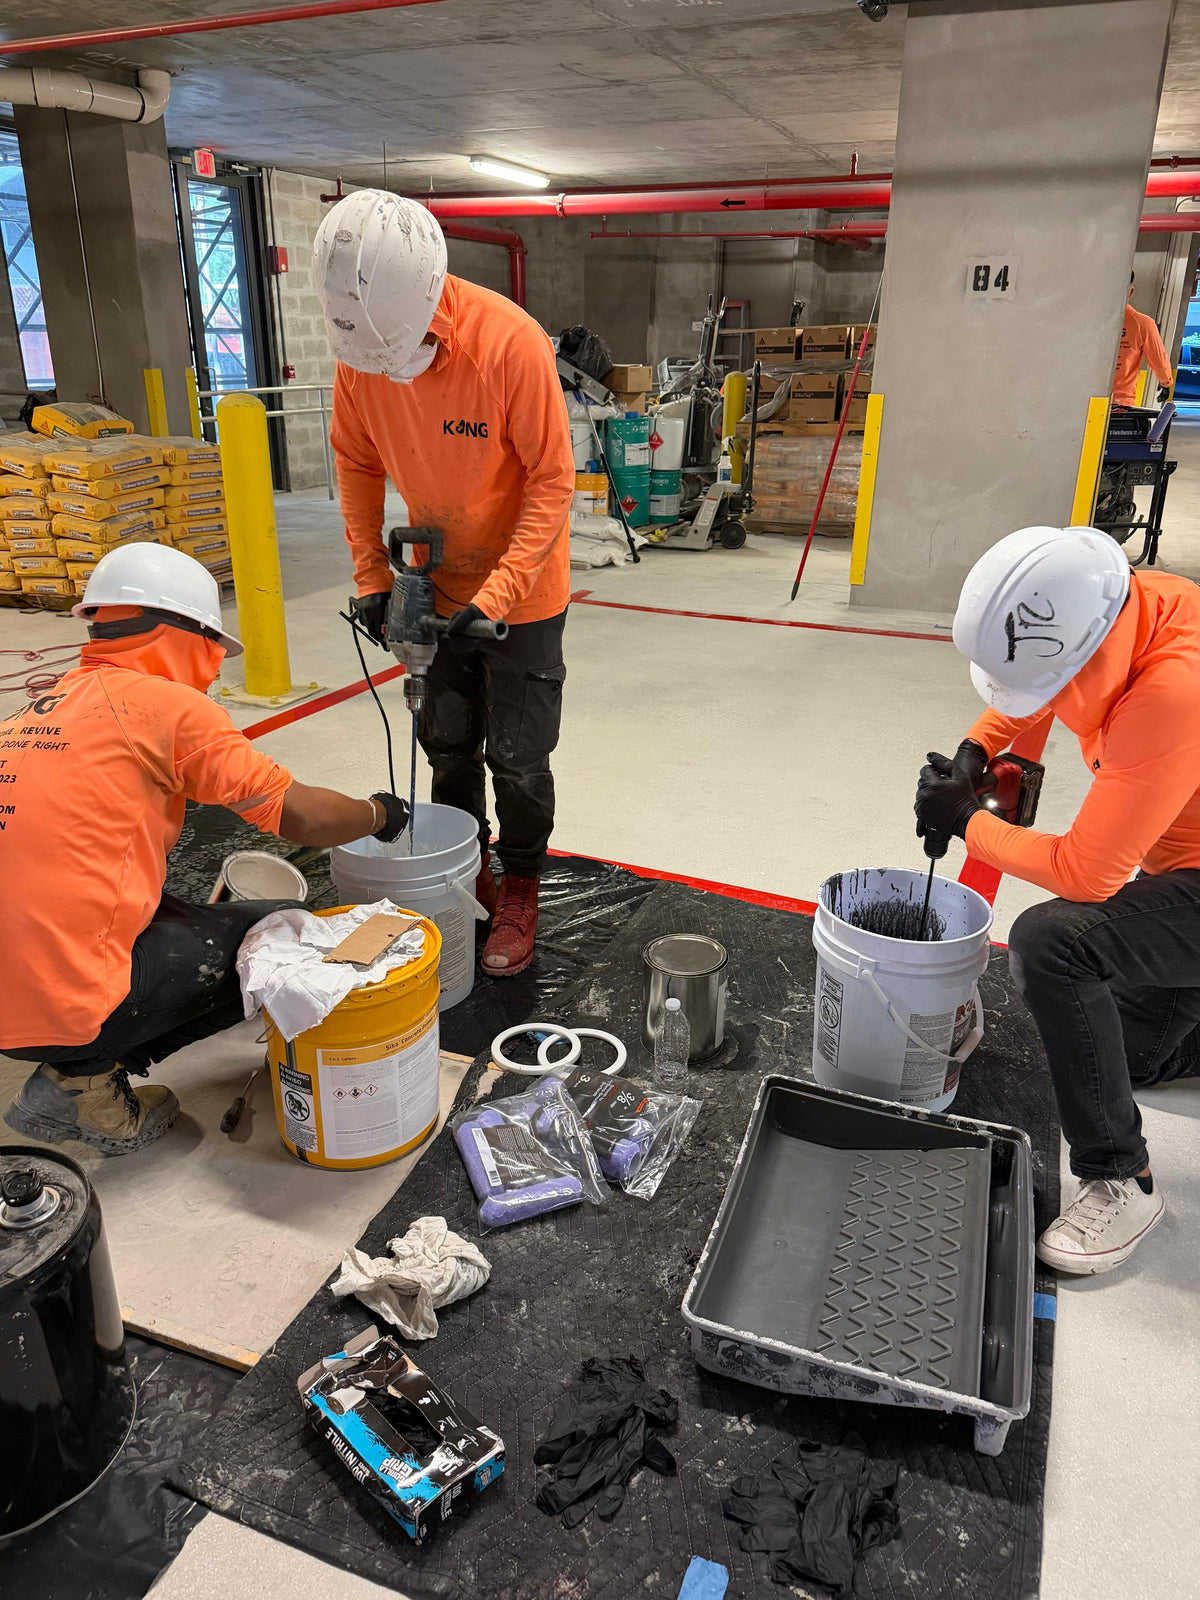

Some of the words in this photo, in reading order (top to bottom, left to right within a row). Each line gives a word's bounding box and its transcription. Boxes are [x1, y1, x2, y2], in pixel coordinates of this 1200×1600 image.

[20, 726, 62, 735] REVIVE
[1, 740, 30, 748] DONE
[32, 741, 70, 750] RIGHT
[401, 1028, 422, 1044] Concrete
[580, 1074, 590, 1082] 3
[324, 1427, 355, 1465] NITRILE
[378, 1460, 405, 1482] GORILLA
[382, 1457, 413, 1480] GRIP
